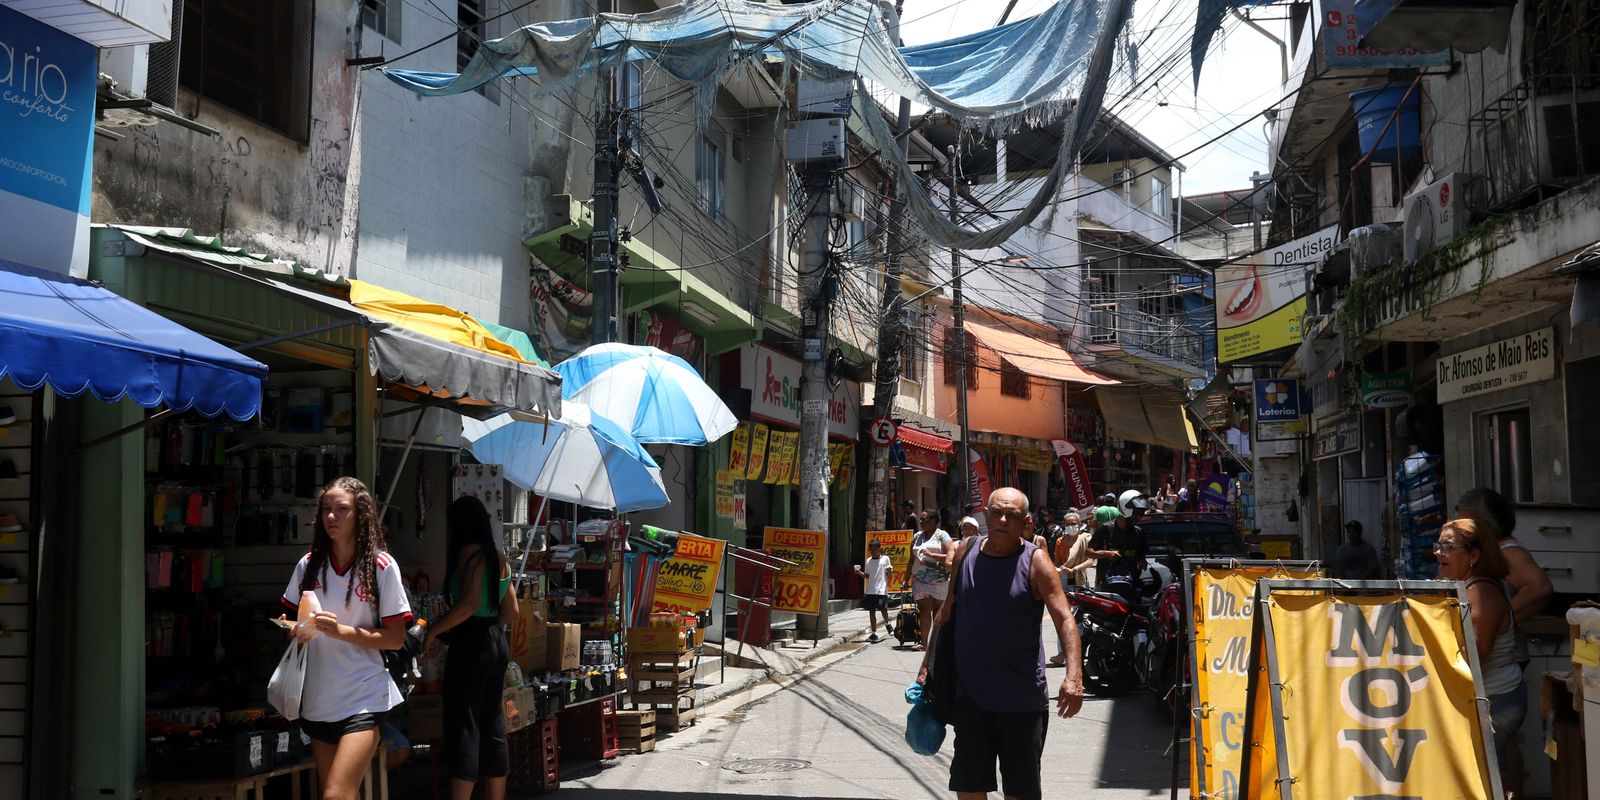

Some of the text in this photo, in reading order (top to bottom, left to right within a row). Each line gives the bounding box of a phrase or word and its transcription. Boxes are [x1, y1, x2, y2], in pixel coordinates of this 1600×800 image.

[23, 46, 67, 105] rio
[3, 89, 75, 122] conforto
[1440, 210, 1449, 225] LG
[1274, 236, 1332, 266] Dentista
[1440, 331, 1549, 385] Dr. Afonso de Maio Reis
[1483, 377, 1502, 389] DENTISTA
[1259, 406, 1297, 417] Loterias
[1065, 456, 1089, 507] GRANPLUS
[775, 532, 817, 546] OFERTA
[659, 560, 709, 581] CARRÉ
[1326, 603, 1429, 800] MÓV
